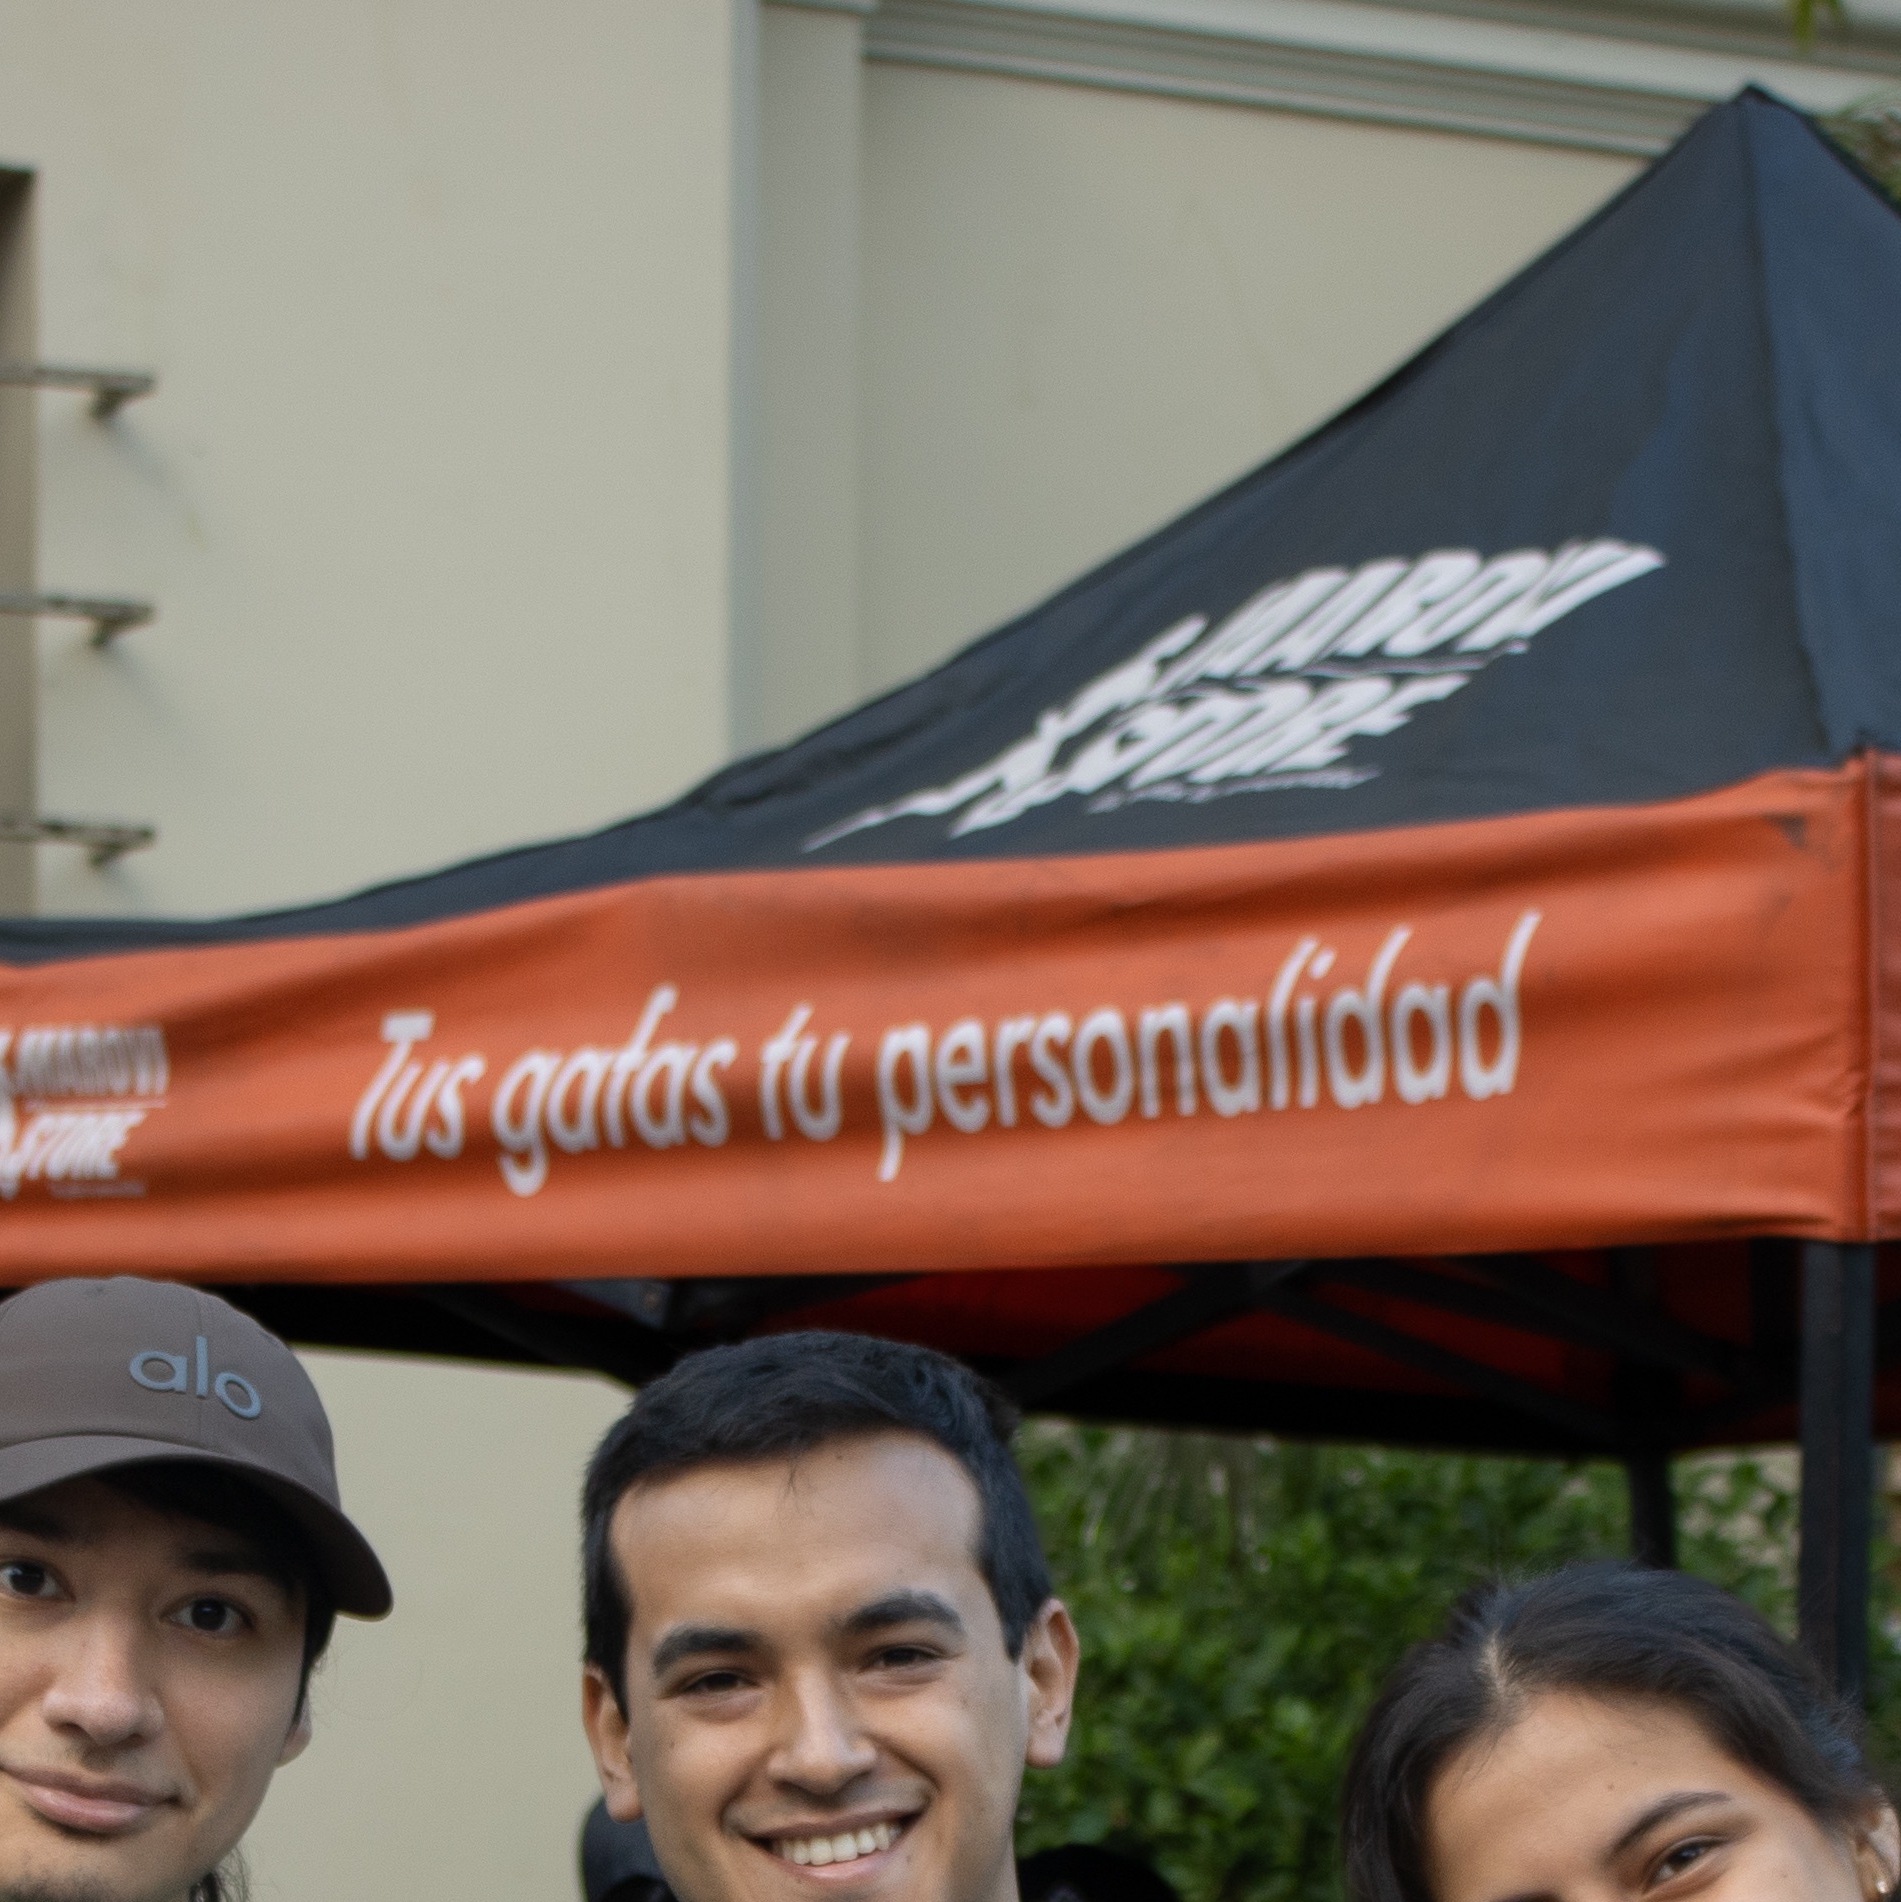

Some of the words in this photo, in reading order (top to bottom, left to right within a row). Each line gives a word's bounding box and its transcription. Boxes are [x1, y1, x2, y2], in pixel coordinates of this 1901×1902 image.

[348, 1008, 486, 1162] Tus
[493, 984, 736, 1198] gafas
[759, 1004, 853, 1145] tu
[874, 908, 1543, 1183] personalidad
[129, 1334, 262, 1419] alo
